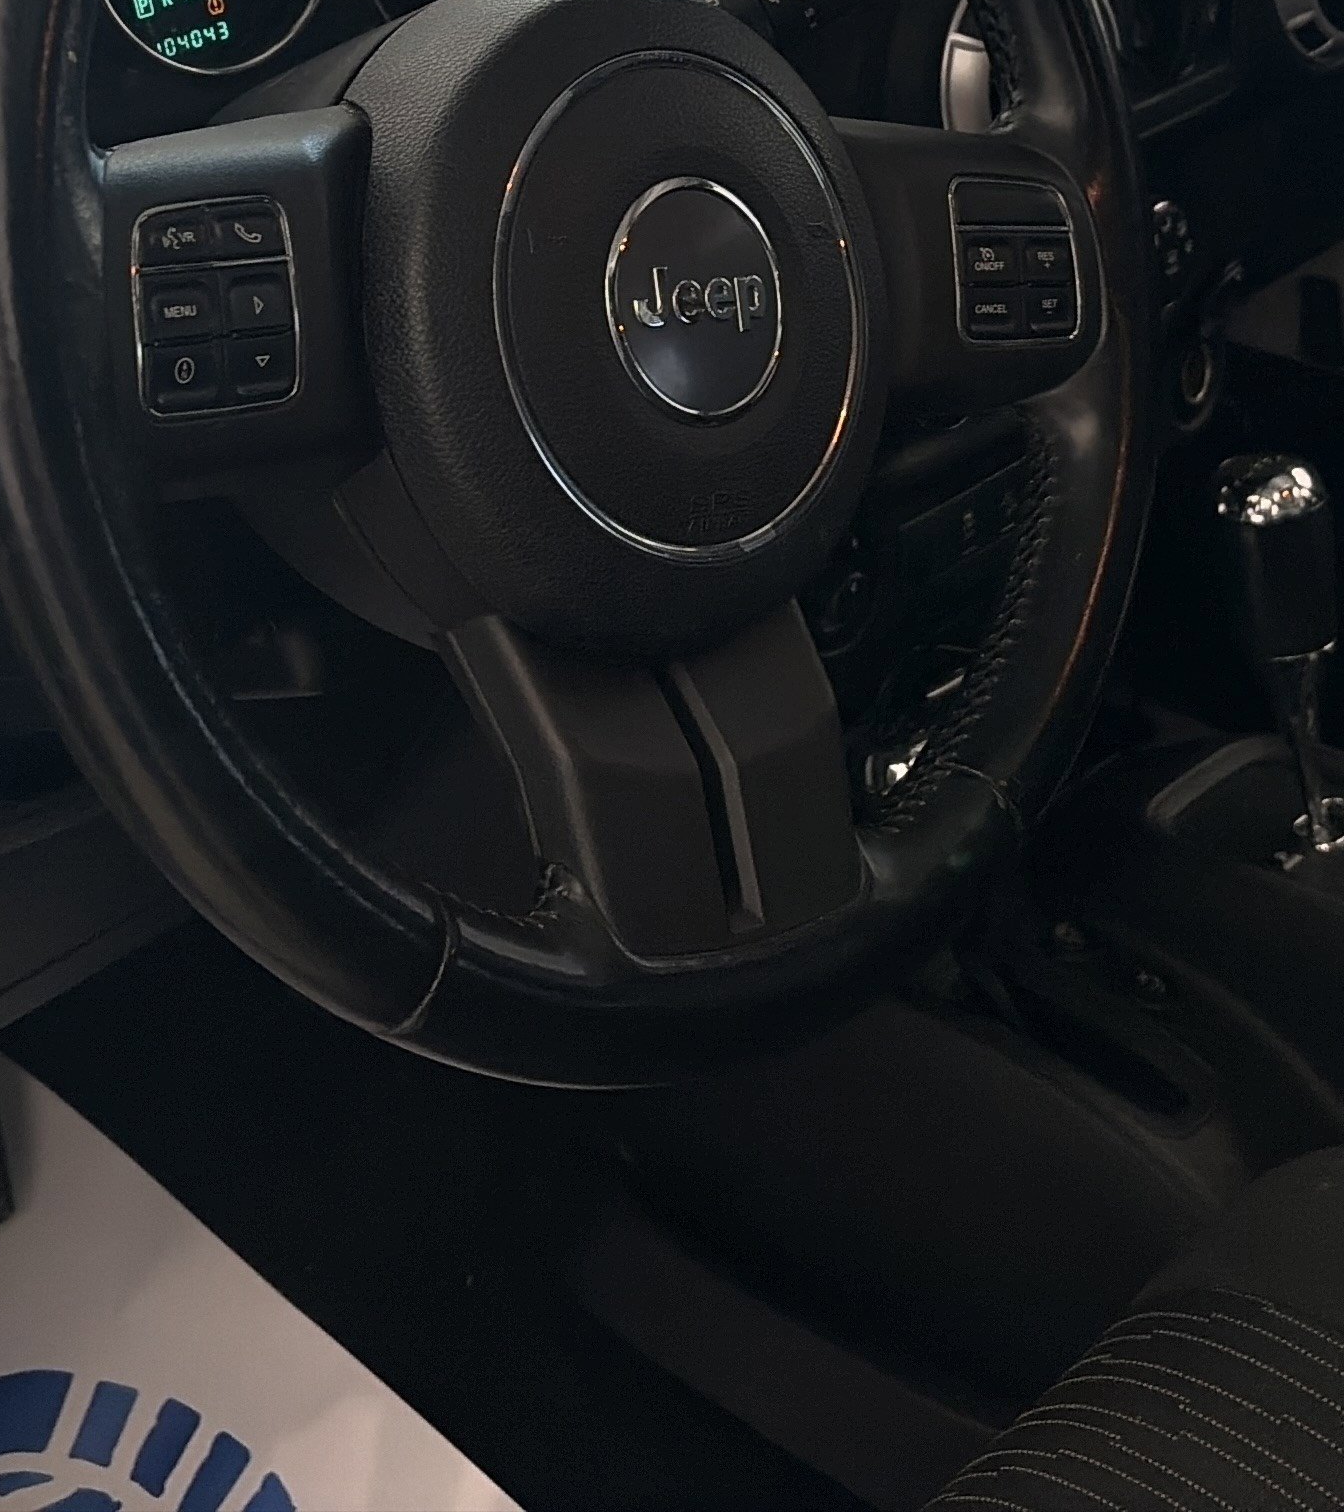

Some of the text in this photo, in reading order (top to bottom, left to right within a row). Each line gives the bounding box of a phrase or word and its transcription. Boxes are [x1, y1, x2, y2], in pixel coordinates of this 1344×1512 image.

[1036, 251, 1055, 261] RES
[633, 266, 767, 333] Jeep
[1041, 298, 1058, 309] SET
[163, 304, 198, 319] MENU
[974, 303, 1008, 315] CANCEL
